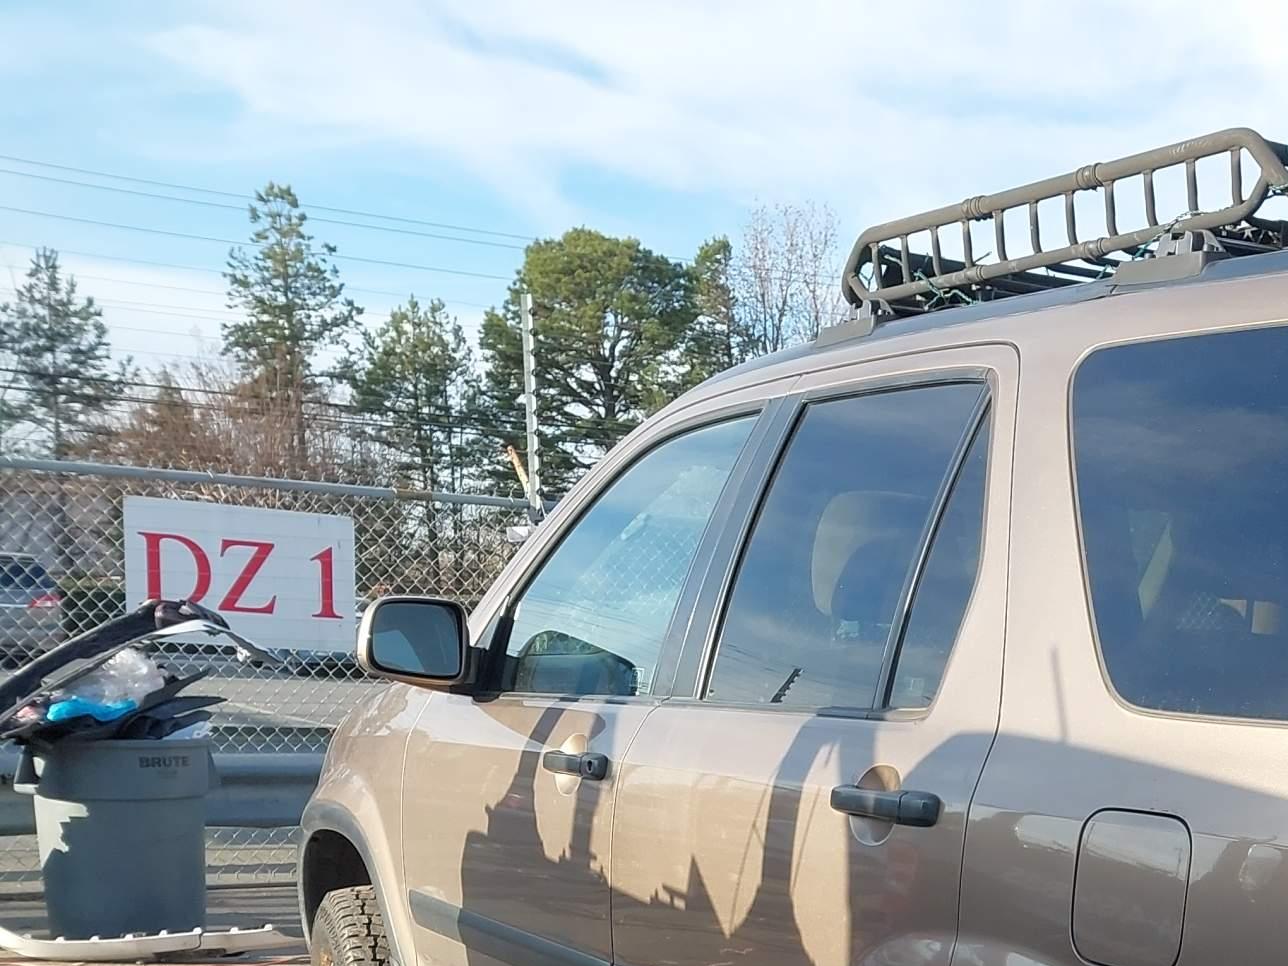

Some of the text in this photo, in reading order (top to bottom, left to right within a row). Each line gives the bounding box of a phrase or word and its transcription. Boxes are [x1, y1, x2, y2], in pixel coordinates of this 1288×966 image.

[137, 531, 343, 619] DZ 1
[138, 755, 191, 769] BRUTE
